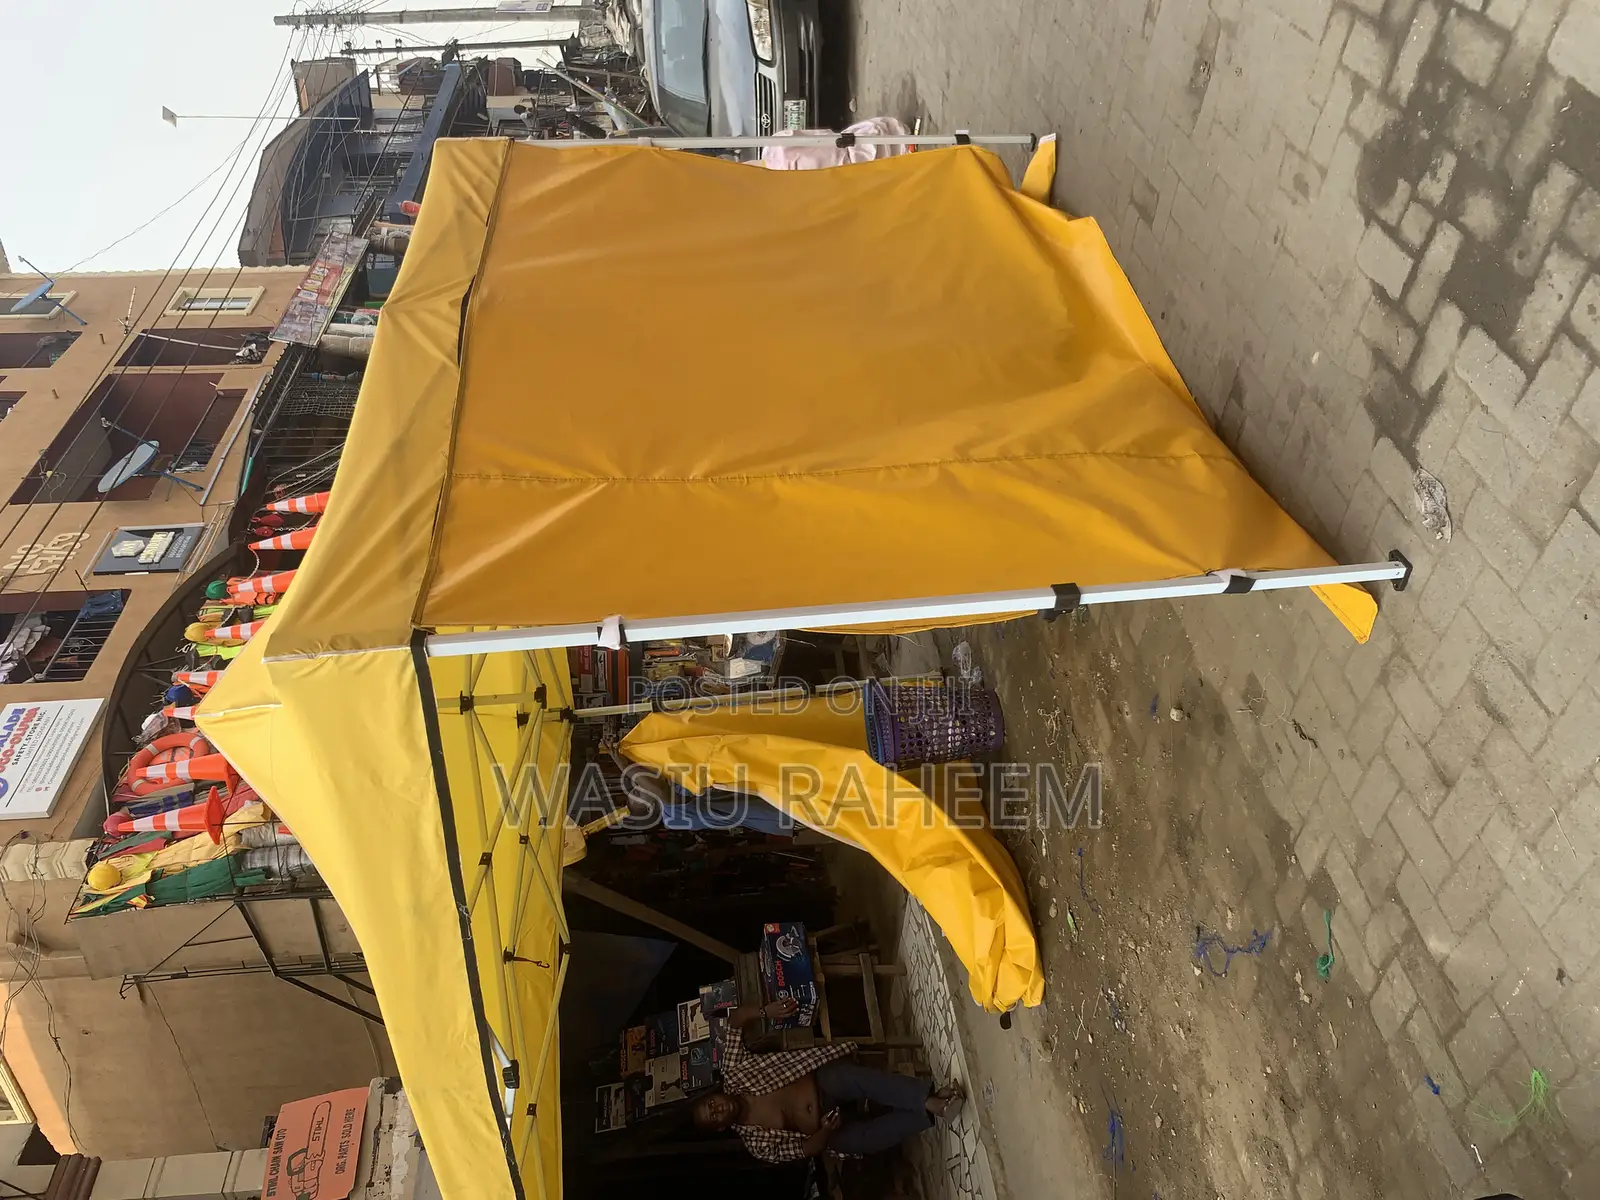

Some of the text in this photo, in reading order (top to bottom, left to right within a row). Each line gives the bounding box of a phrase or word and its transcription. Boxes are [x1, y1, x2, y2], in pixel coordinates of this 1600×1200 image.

[775, 959, 786, 987] BOSCH
[344, 1108, 356, 1122] HERE
[312, 1116, 324, 1142] STIHL
[341, 1124, 353, 1138] SOLD
[272, 1140, 285, 1154] SAW
[338, 1140, 350, 1159] PARTS
[269, 1155, 282, 1176] CHAIN
[266, 1176, 278, 1196] STIHL
